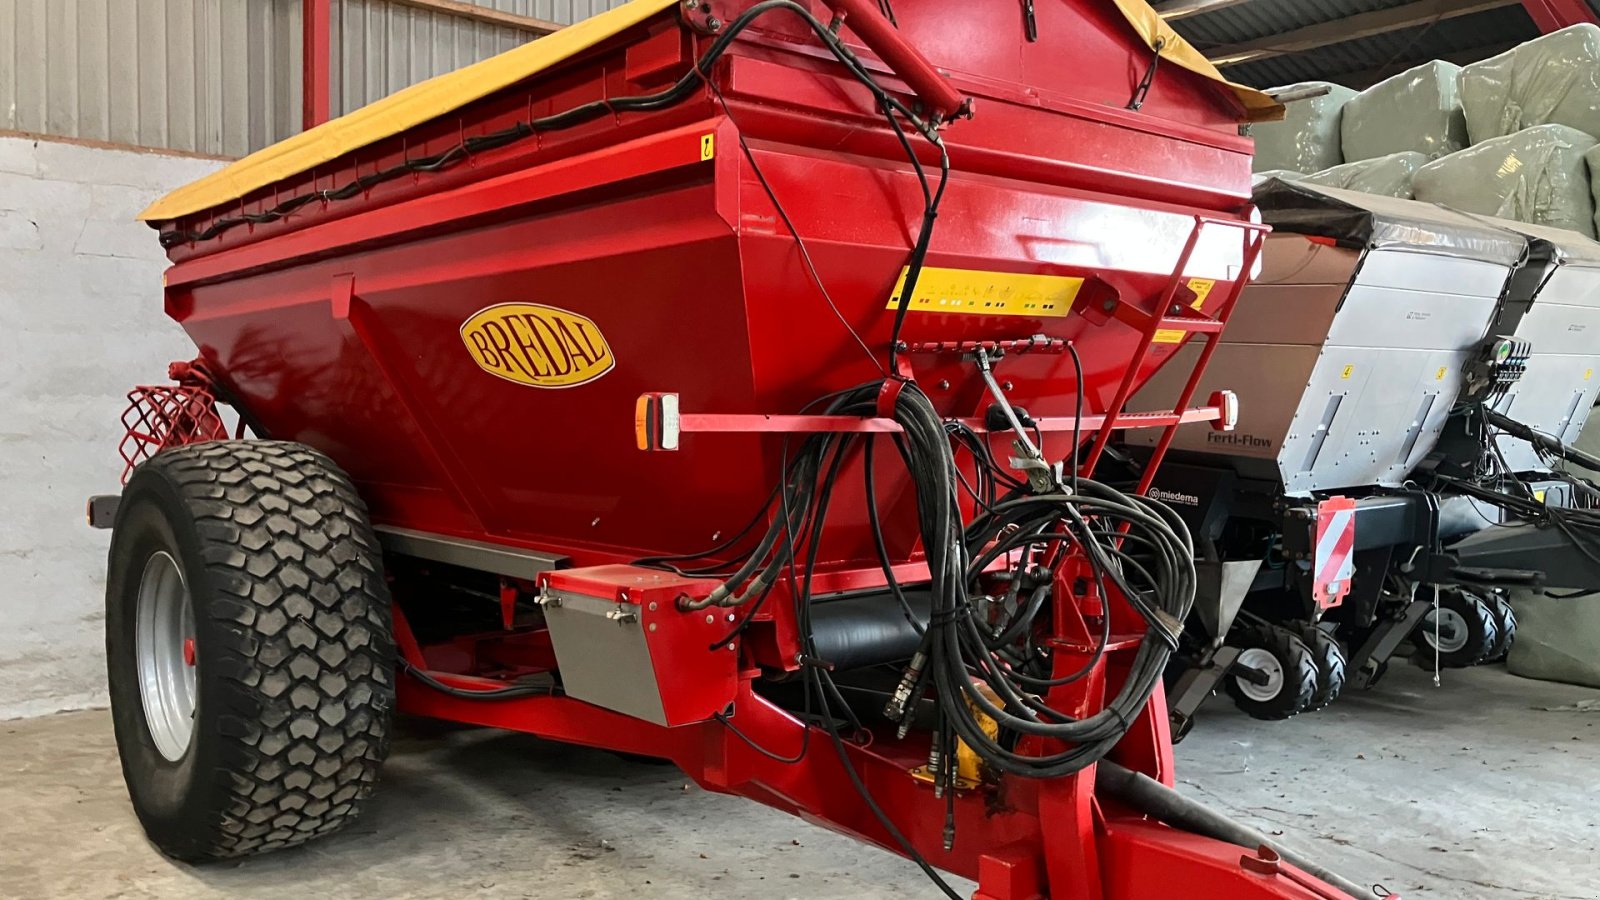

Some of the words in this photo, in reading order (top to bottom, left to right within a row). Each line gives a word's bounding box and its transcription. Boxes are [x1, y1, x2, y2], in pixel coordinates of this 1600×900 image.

[470, 314, 605, 380] BREDAL
[1207, 432, 1272, 448] Ferti-Flow
[1160, 491, 1199, 503] miedema
